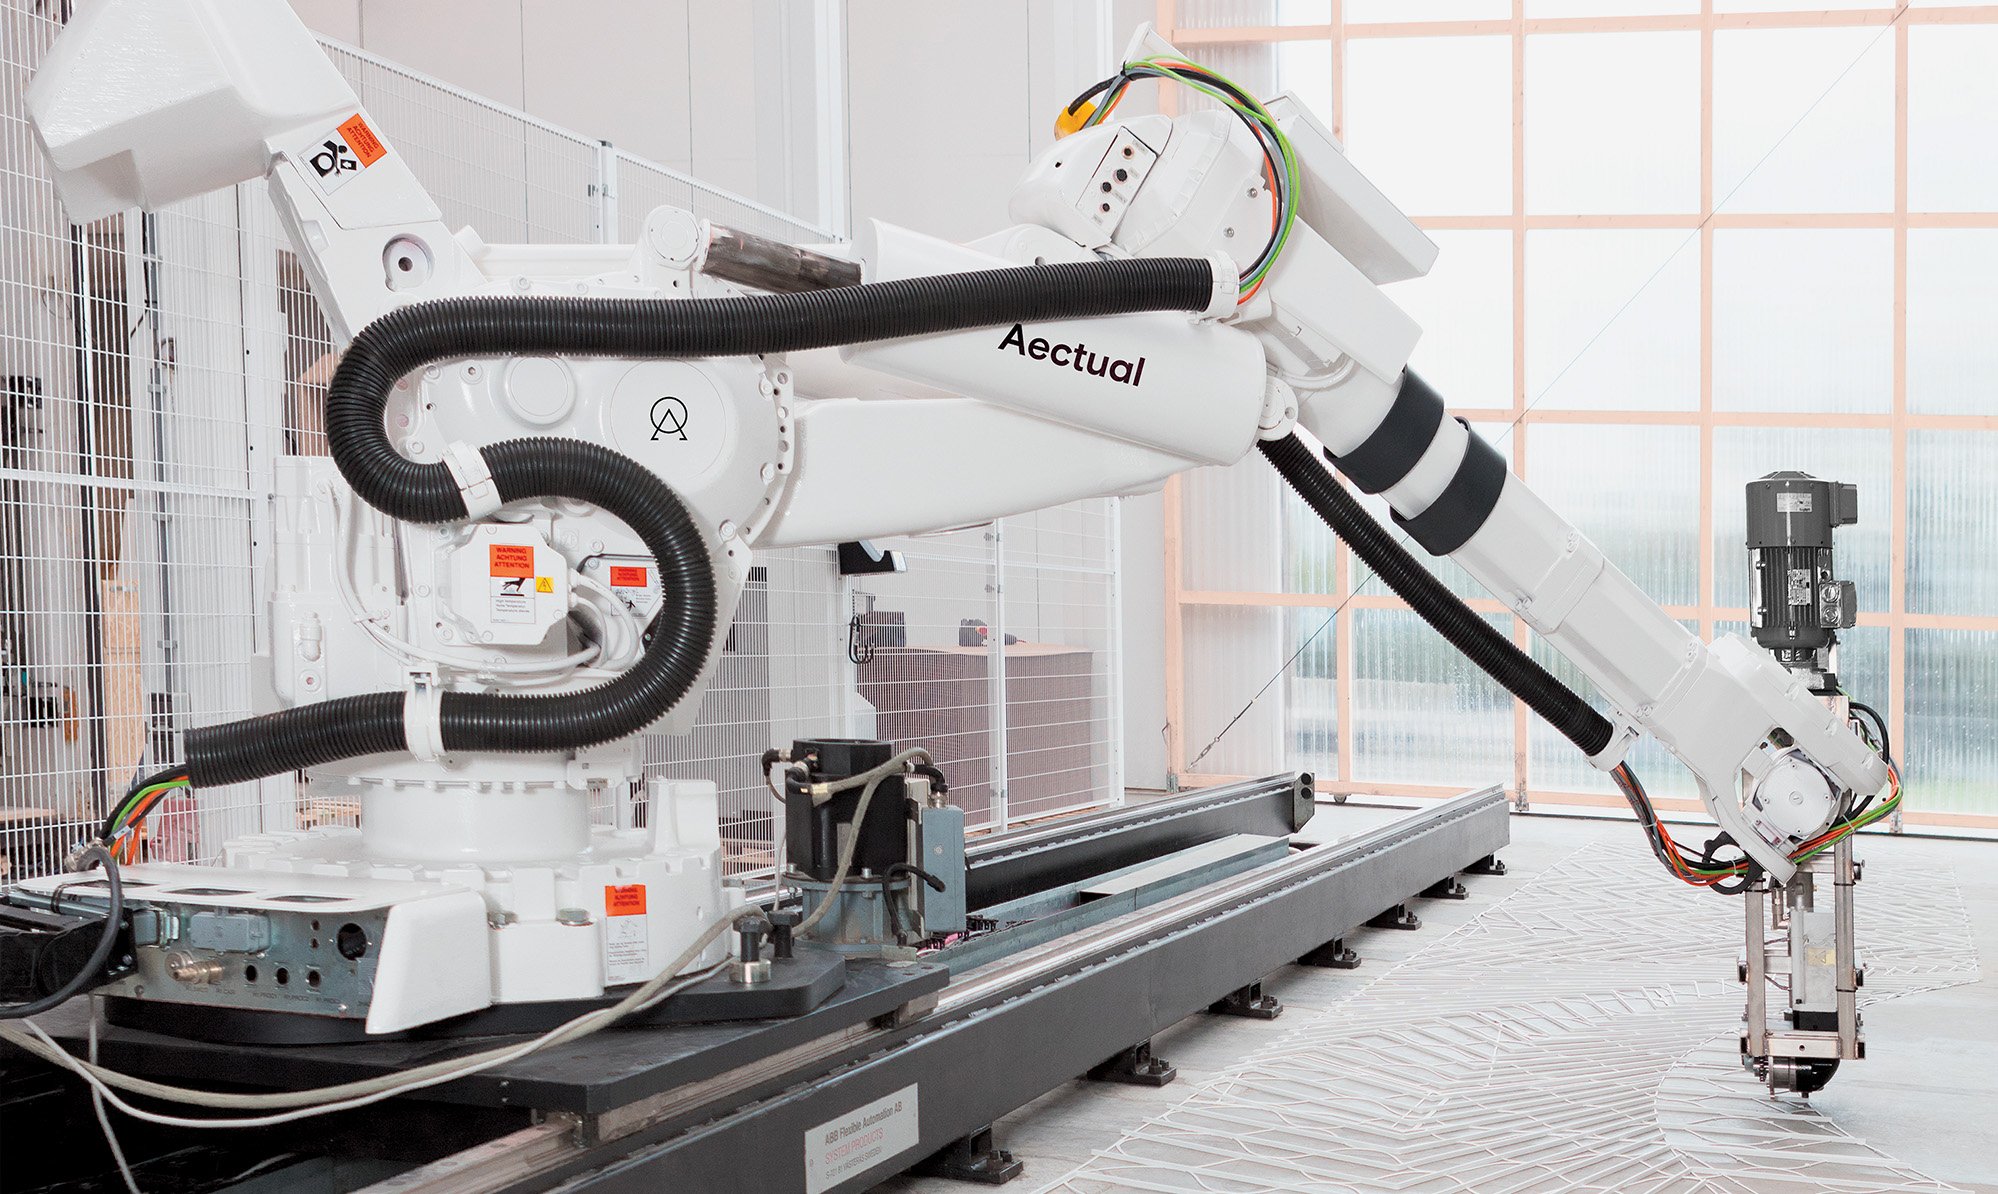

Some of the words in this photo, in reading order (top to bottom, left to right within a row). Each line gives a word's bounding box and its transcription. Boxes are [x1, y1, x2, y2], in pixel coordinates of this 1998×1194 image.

[346, 127, 371, 158] ATTENTION
[353, 125, 375, 153] ACHTUNG
[358, 122, 379, 149] WARNING
[998, 323, 1145, 386] Aectual
[494, 561, 530, 569] ATTENTION
[825, 1130, 839, 1146] ABB
[840, 1121, 861, 1140] Flexible
[862, 1107, 894, 1129] Automation
[894, 1101, 903, 1114] AB
[825, 1145, 850, 1165] SYSTEM
[851, 1127, 884, 1151] PRODUCTS
